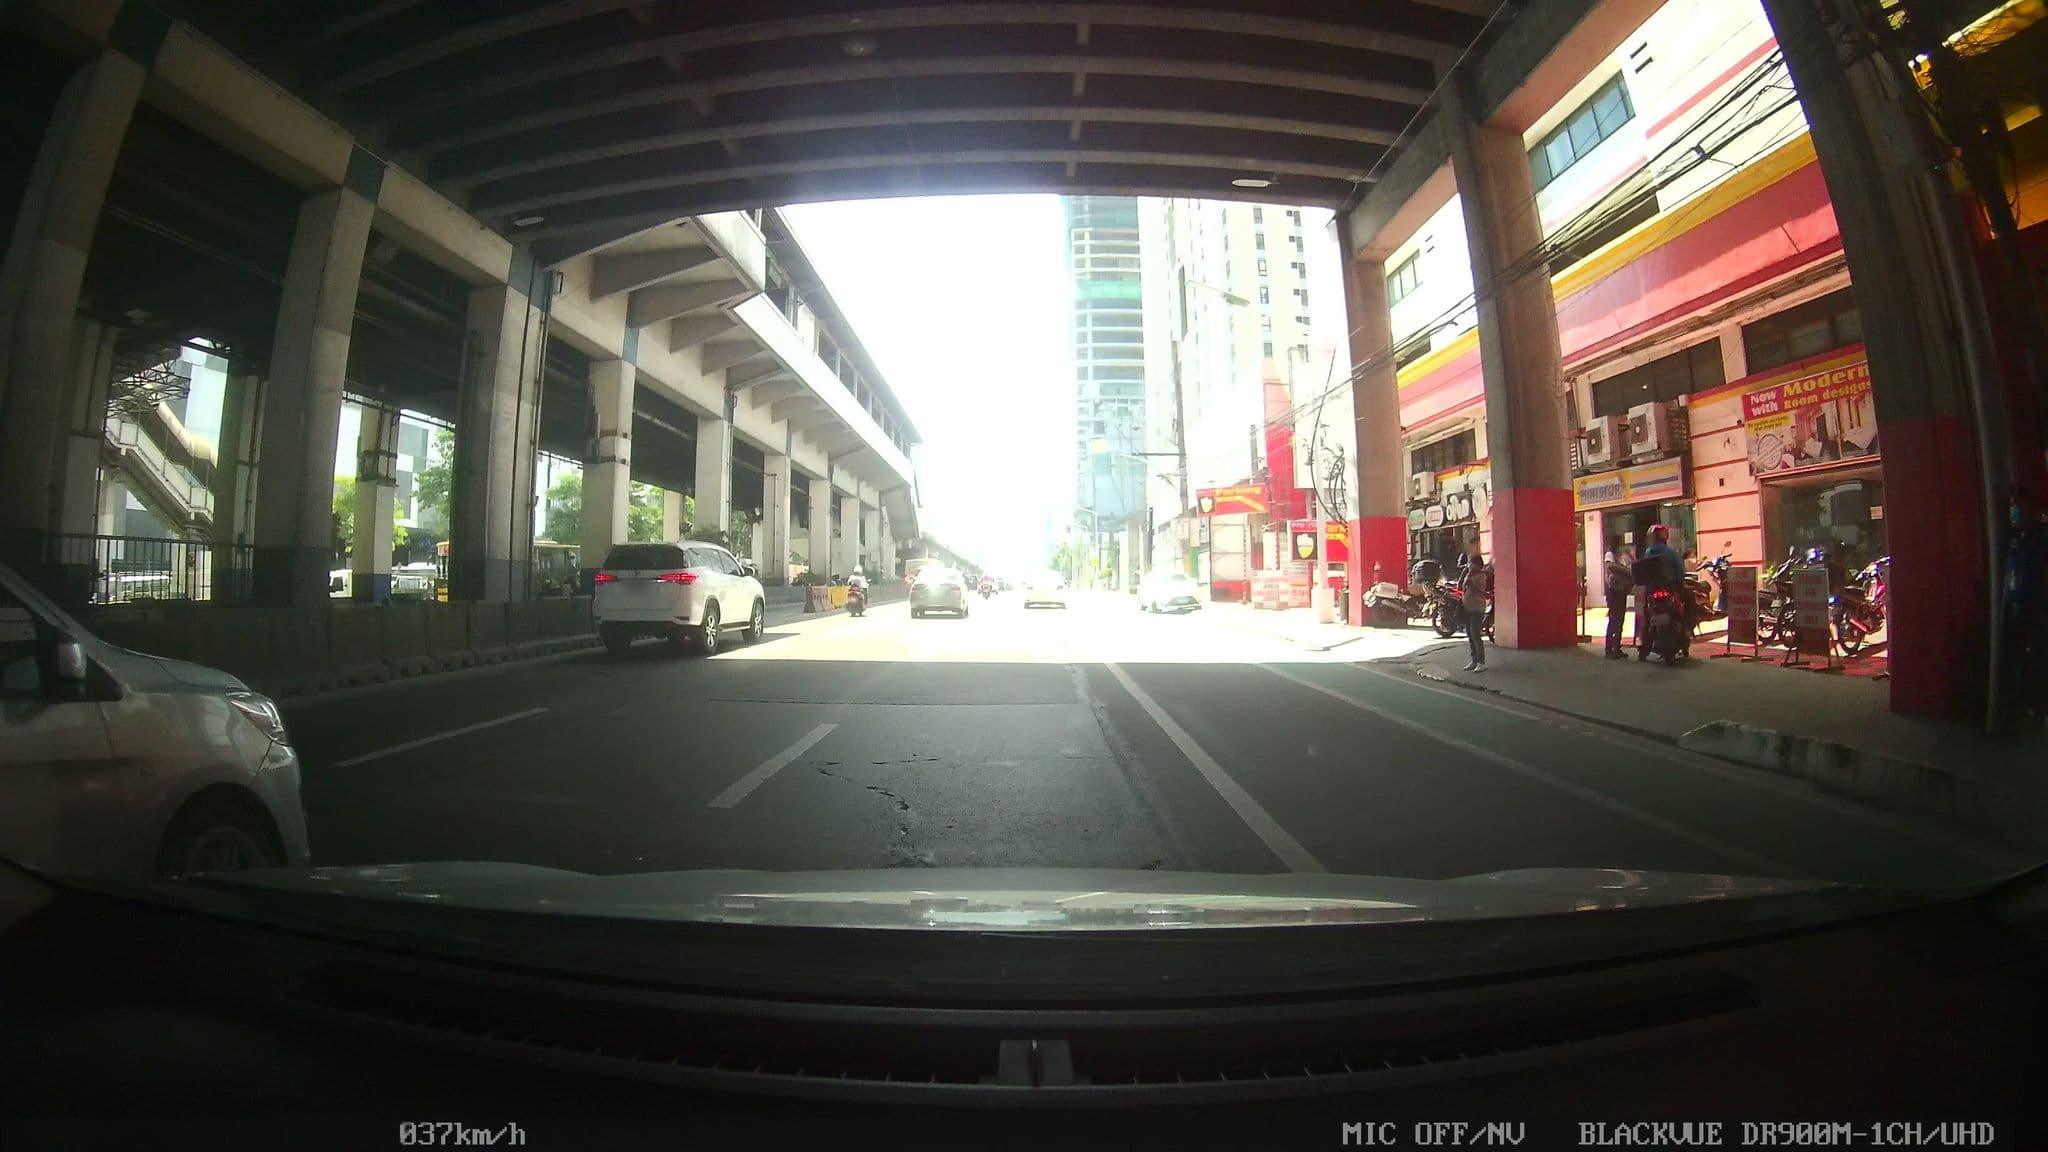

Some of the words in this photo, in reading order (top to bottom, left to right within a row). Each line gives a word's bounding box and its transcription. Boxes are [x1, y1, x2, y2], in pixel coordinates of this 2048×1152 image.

[1783, 366, 1868, 397] Modern
[1750, 390, 1777, 405] Now
[1784, 394, 1818, 409] Room
[1752, 401, 1779, 416] with
